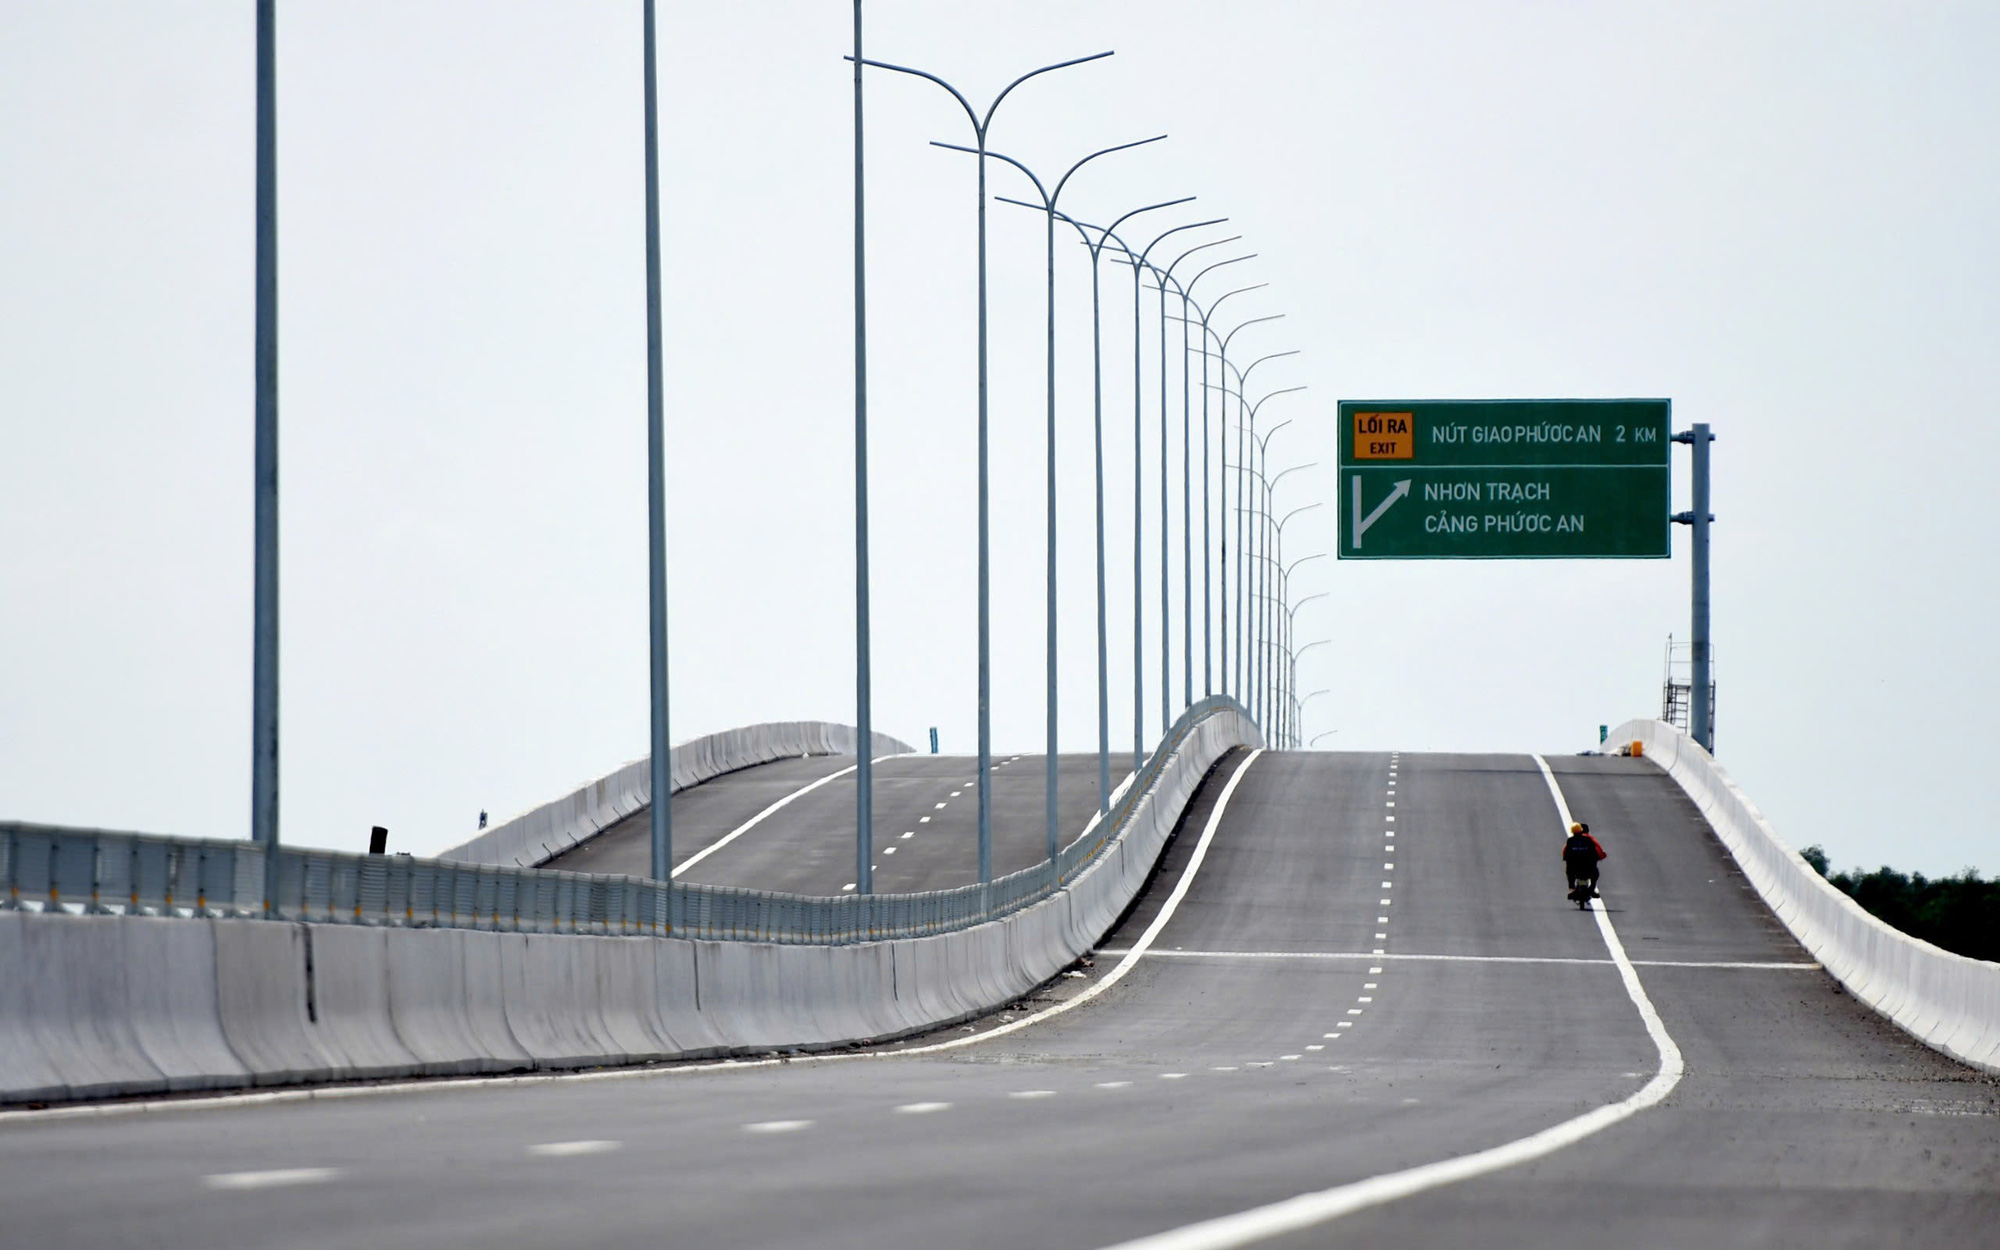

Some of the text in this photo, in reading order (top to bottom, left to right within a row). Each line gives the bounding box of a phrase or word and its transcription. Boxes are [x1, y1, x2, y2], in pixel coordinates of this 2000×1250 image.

[1387, 418, 1407, 434] RA
[1432, 421, 1468, 443] NÚT
[1472, 425, 1512, 443] GIAO
[1576, 425, 1601, 442] AN
[1616, 424, 1626, 442] 2
[1635, 427, 1656, 442] KM
[1370, 442, 1397, 454] EXIT
[1425, 482, 1550, 503] NHƠN TRẠCH
[1425, 510, 1478, 532] CẢNG
[1556, 515, 1584, 532] AN
